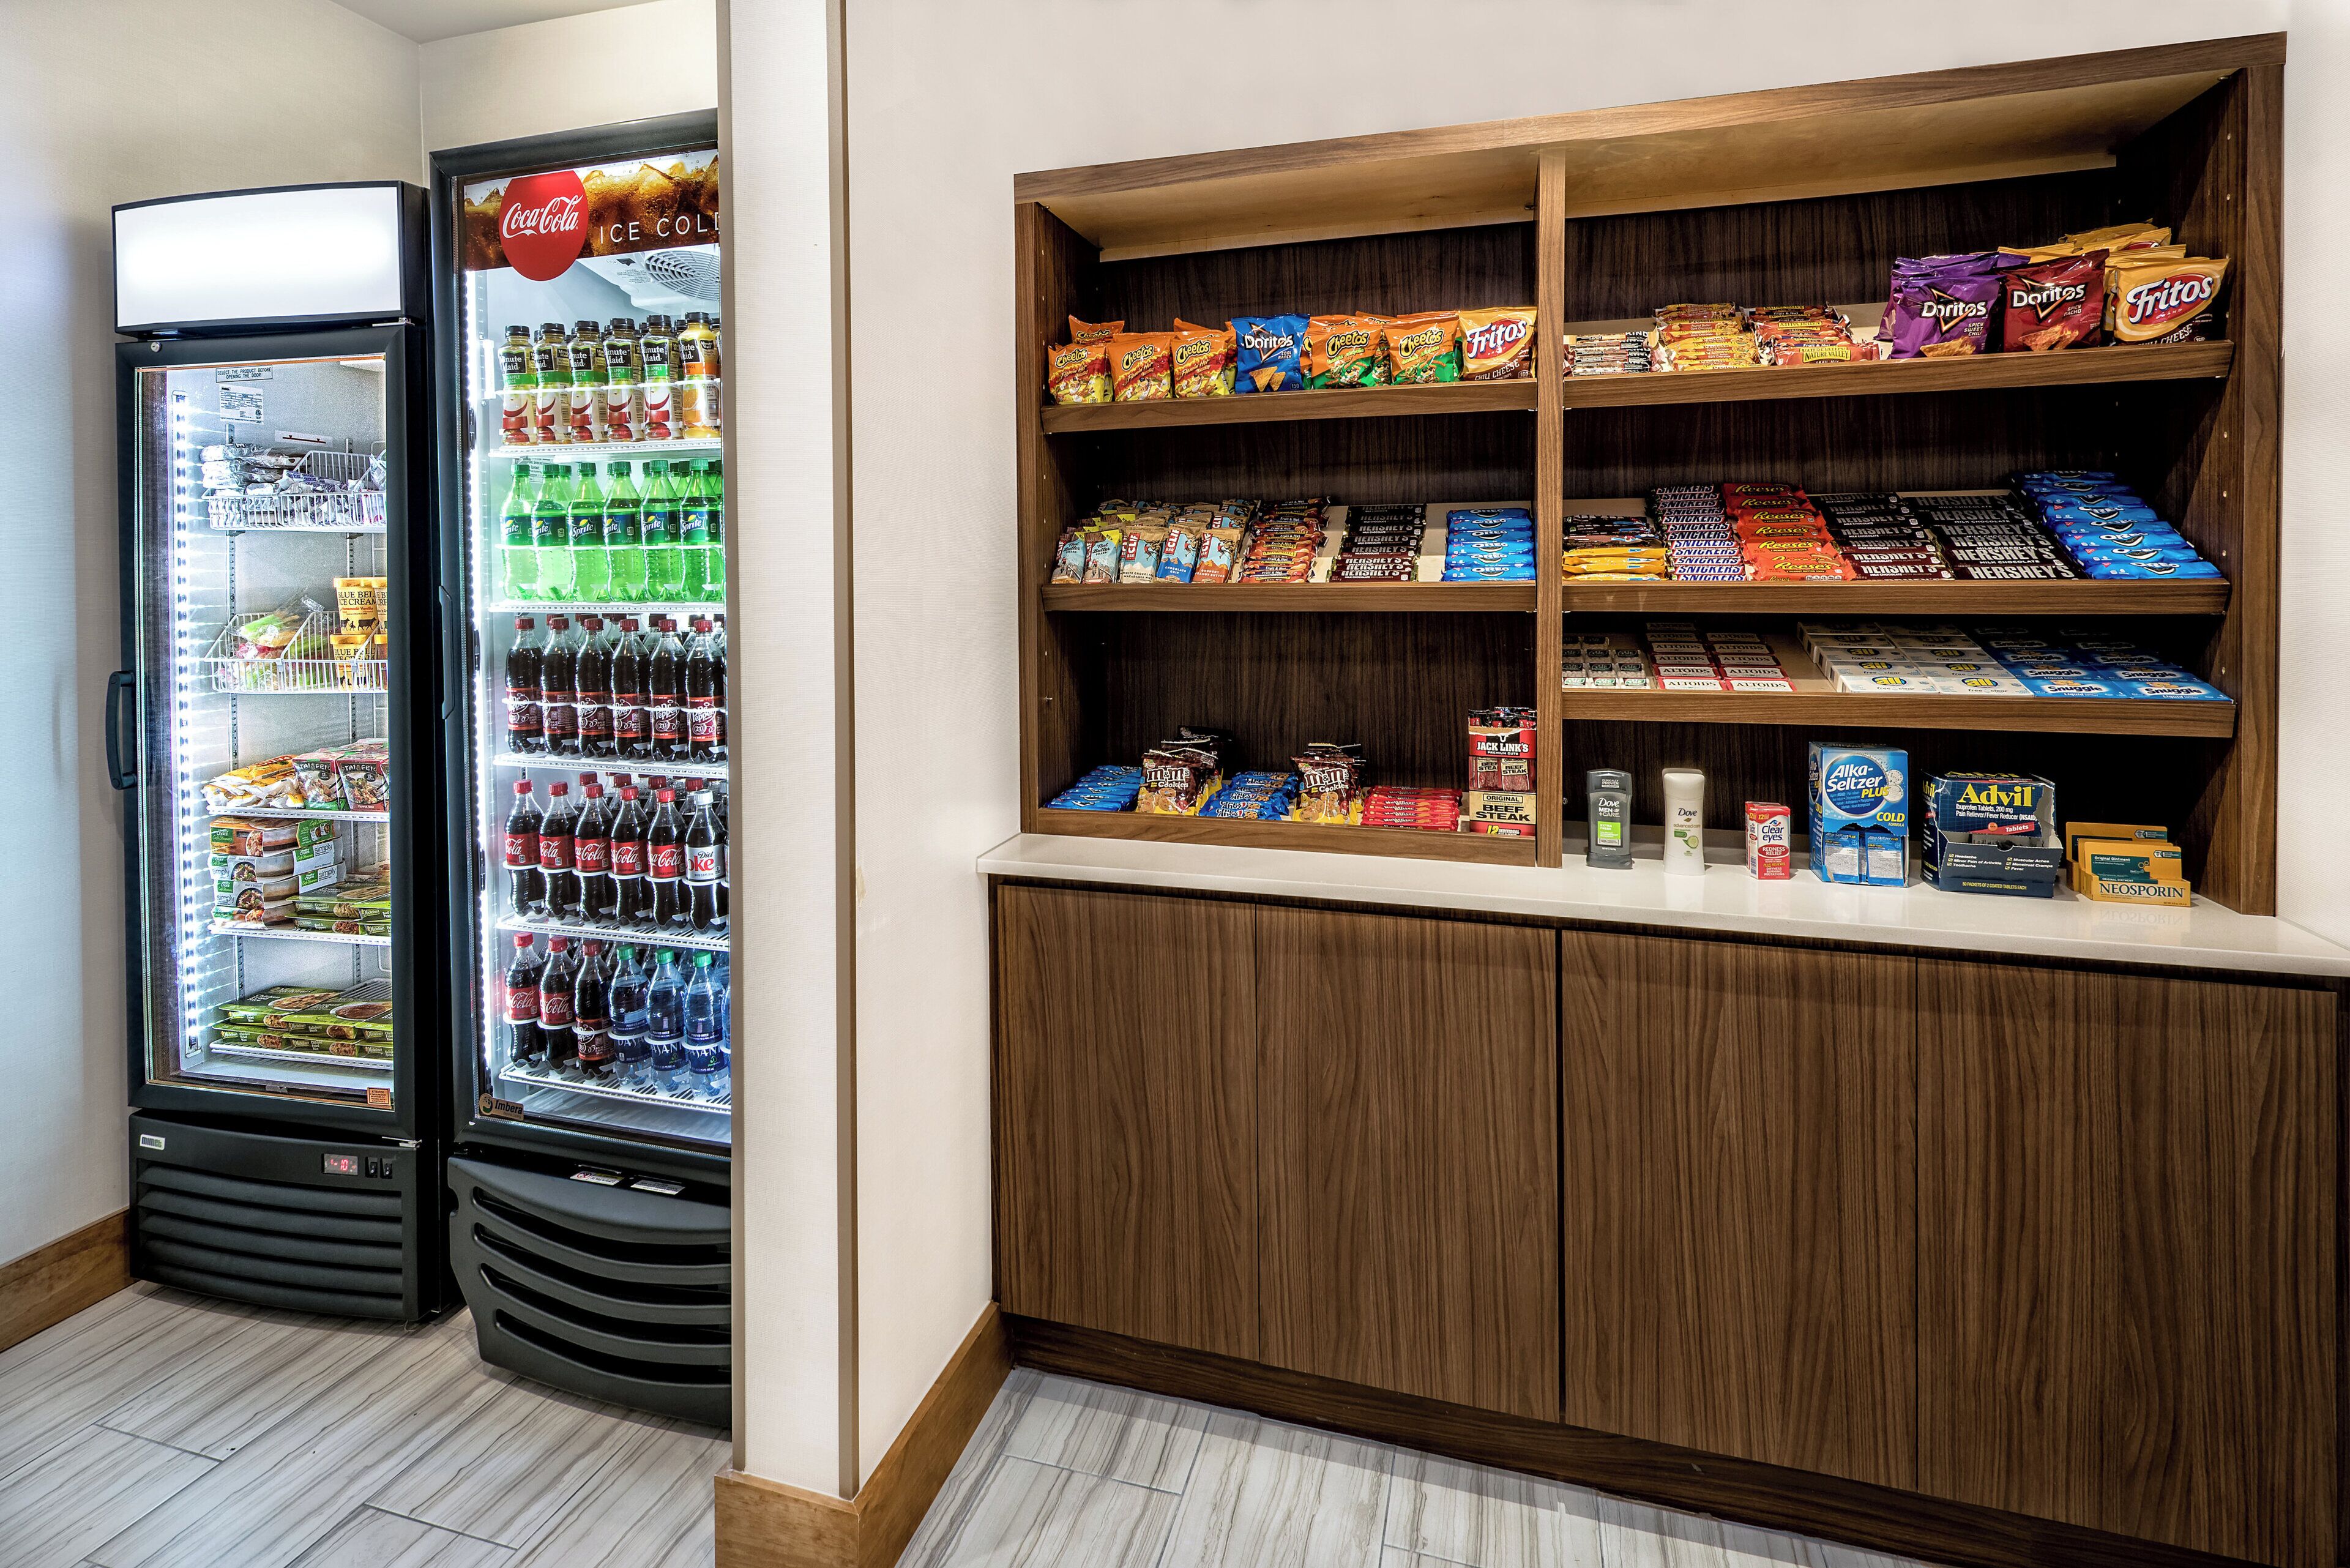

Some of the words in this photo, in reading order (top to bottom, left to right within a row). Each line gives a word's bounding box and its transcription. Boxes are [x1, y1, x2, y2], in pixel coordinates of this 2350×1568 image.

[502, 195, 583, 238] Coca-Cola
[600, 222, 640, 244] ICE
[2013, 285, 2085, 307] Doritos
[2126, 277, 2213, 324] Fritos
[1922, 301, 1987, 317] Doritos
[1244, 335, 1294, 348] Doritos
[1327, 330, 1370, 357] Cheetos
[1399, 328, 1444, 359] Cheetos
[1467, 319, 1527, 359] Fritos
[1122, 345, 1154, 370] Cheetos
[1176, 341, 1210, 364] Cheetos
[1475, 372, 1490, 381] CHILI
[1493, 358, 1520, 378] CHEESE
[572, 523, 594, 537] Sprite
[682, 520, 704, 534] Sprite
[1670, 531, 1730, 540] SNICKERS
[1950, 535, 2051, 547] HERSHEY'S
[1128, 534, 1140, 553] CLIF
[1759, 540, 1813, 549] Reese's
[1952, 548, 2056, 561] HERSHEY'S
[1774, 562, 1832, 570] Reese's
[1968, 566, 2075, 579] HERSHEY'S
[1477, 742, 1498, 752] JACK
[1500, 743, 1529, 752] LINK'S
[1147, 767, 1190, 782] m&m's
[1830, 764, 1873, 778] Alka-
[1827, 776, 1883, 792] Seltzer
[1862, 786, 1890, 798] PLUS
[1957, 783, 2032, 807] Advil
[1598, 797, 1620, 807] Dove
[1476, 812, 1531, 821] STEAK
[1876, 812, 1905, 823] COLD
[1486, 825, 1499, 834] 12
[1762, 834, 1783, 843] eyes
[314, 844, 332, 853] simply
[575, 842, 606, 861] ca-Cola
[648, 846, 684, 867] ca-Cola
[687, 856, 714, 872] oke
[2099, 883, 2183, 897] NEOSPORIN
[494, 1100, 523, 1114] Imbera
